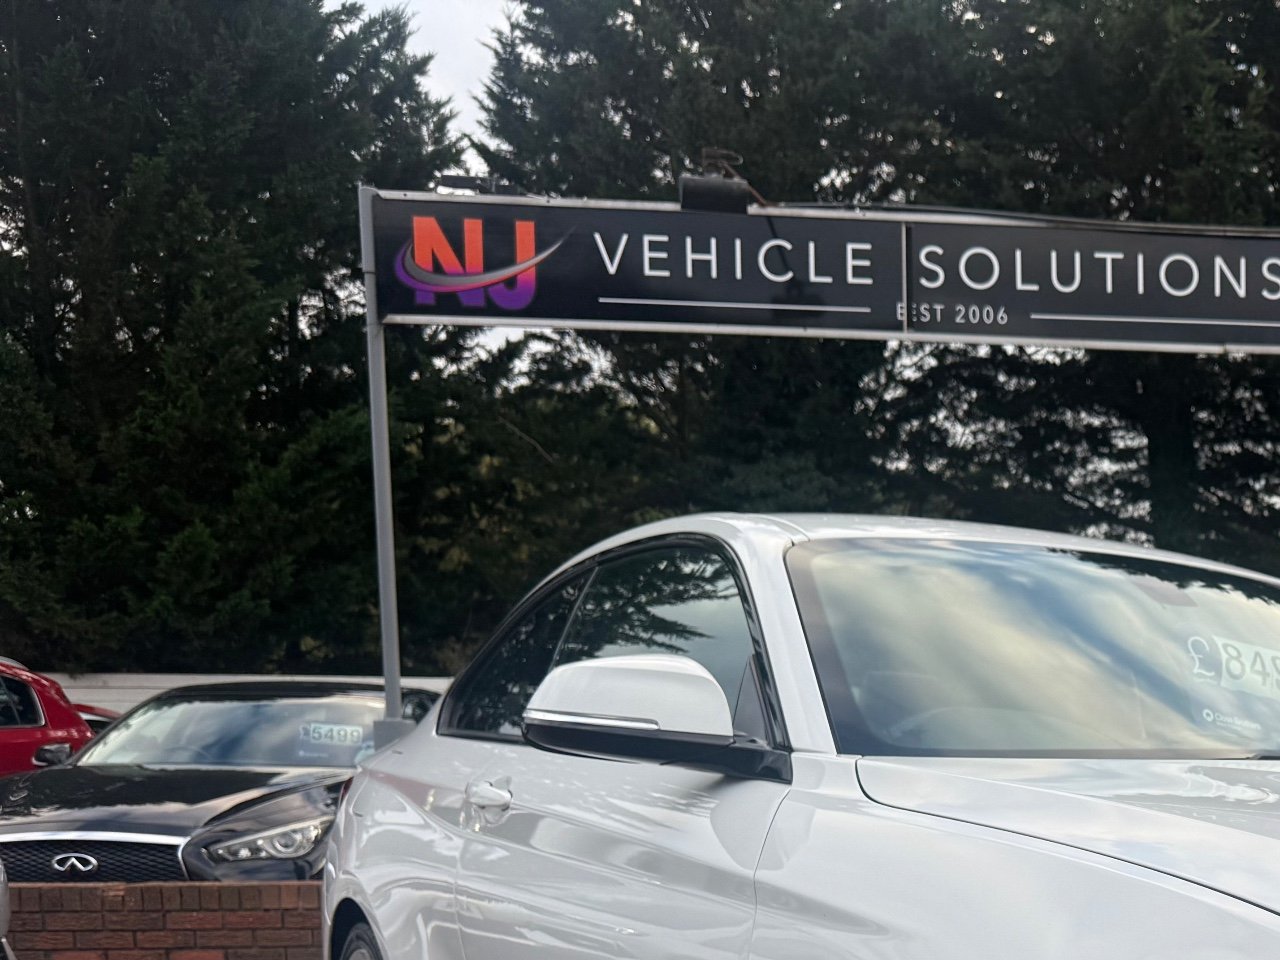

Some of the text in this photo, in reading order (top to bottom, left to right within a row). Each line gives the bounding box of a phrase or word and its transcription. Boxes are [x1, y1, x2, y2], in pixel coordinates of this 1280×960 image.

[411, 216, 536, 311] NJ
[594, 232, 873, 285] VEHICLE
[896, 302, 1008, 326] EST 2006
